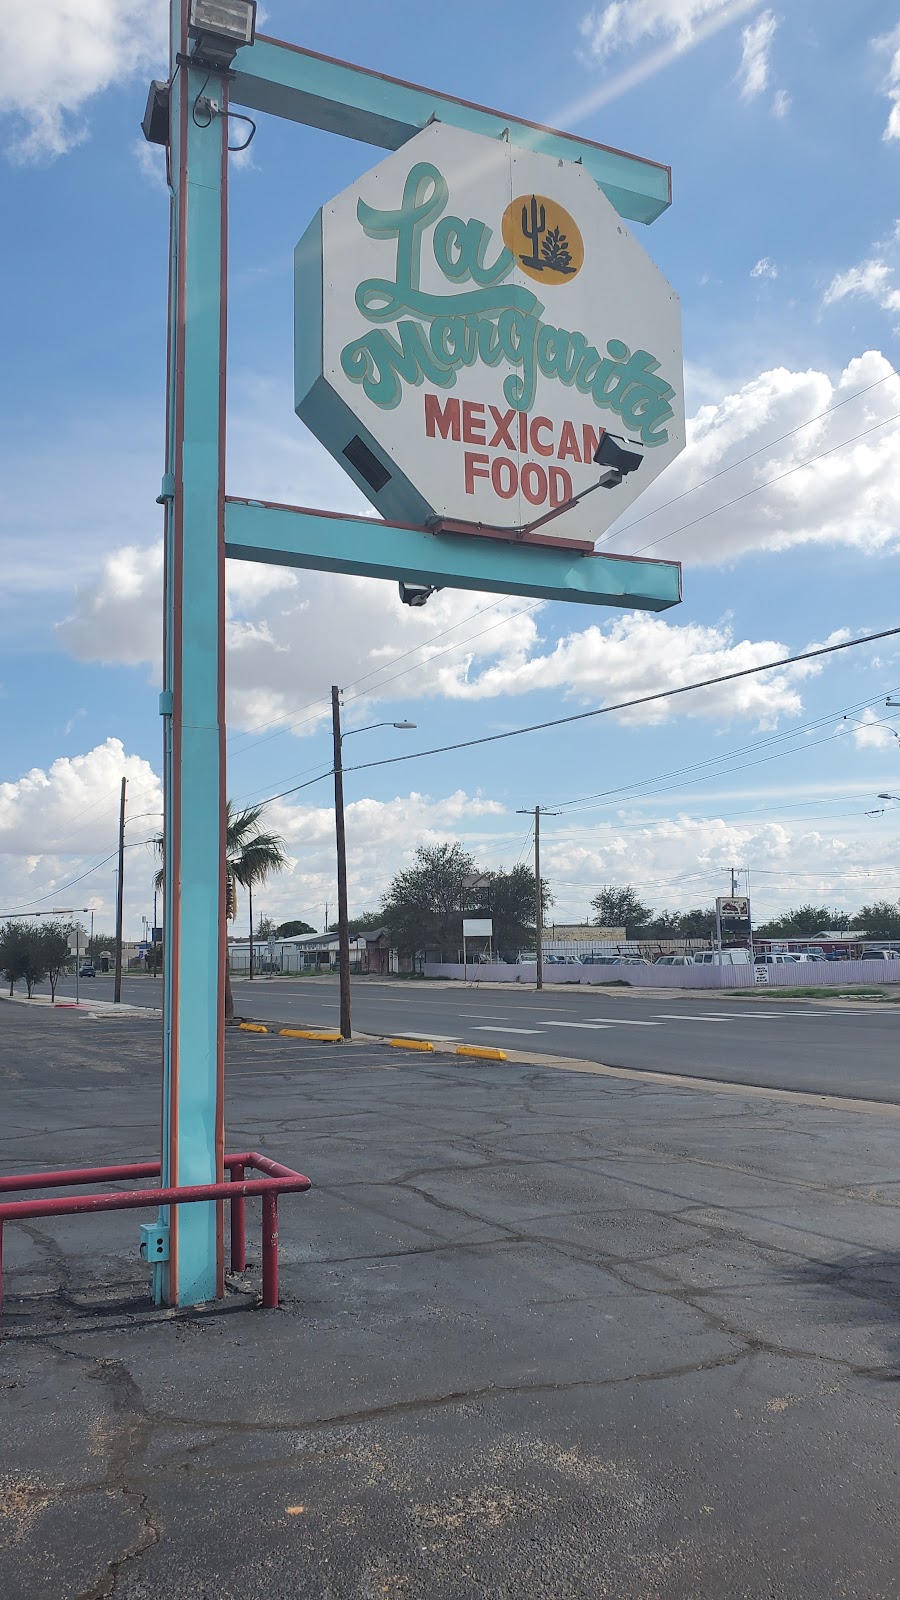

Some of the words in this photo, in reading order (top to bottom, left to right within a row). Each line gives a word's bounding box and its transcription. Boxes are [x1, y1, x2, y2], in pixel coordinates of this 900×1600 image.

[355, 162, 545, 323] La
[340, 308, 676, 447] Margarita
[424, 394, 606, 464] MEXICAN
[464, 452, 573, 508] FOOD
